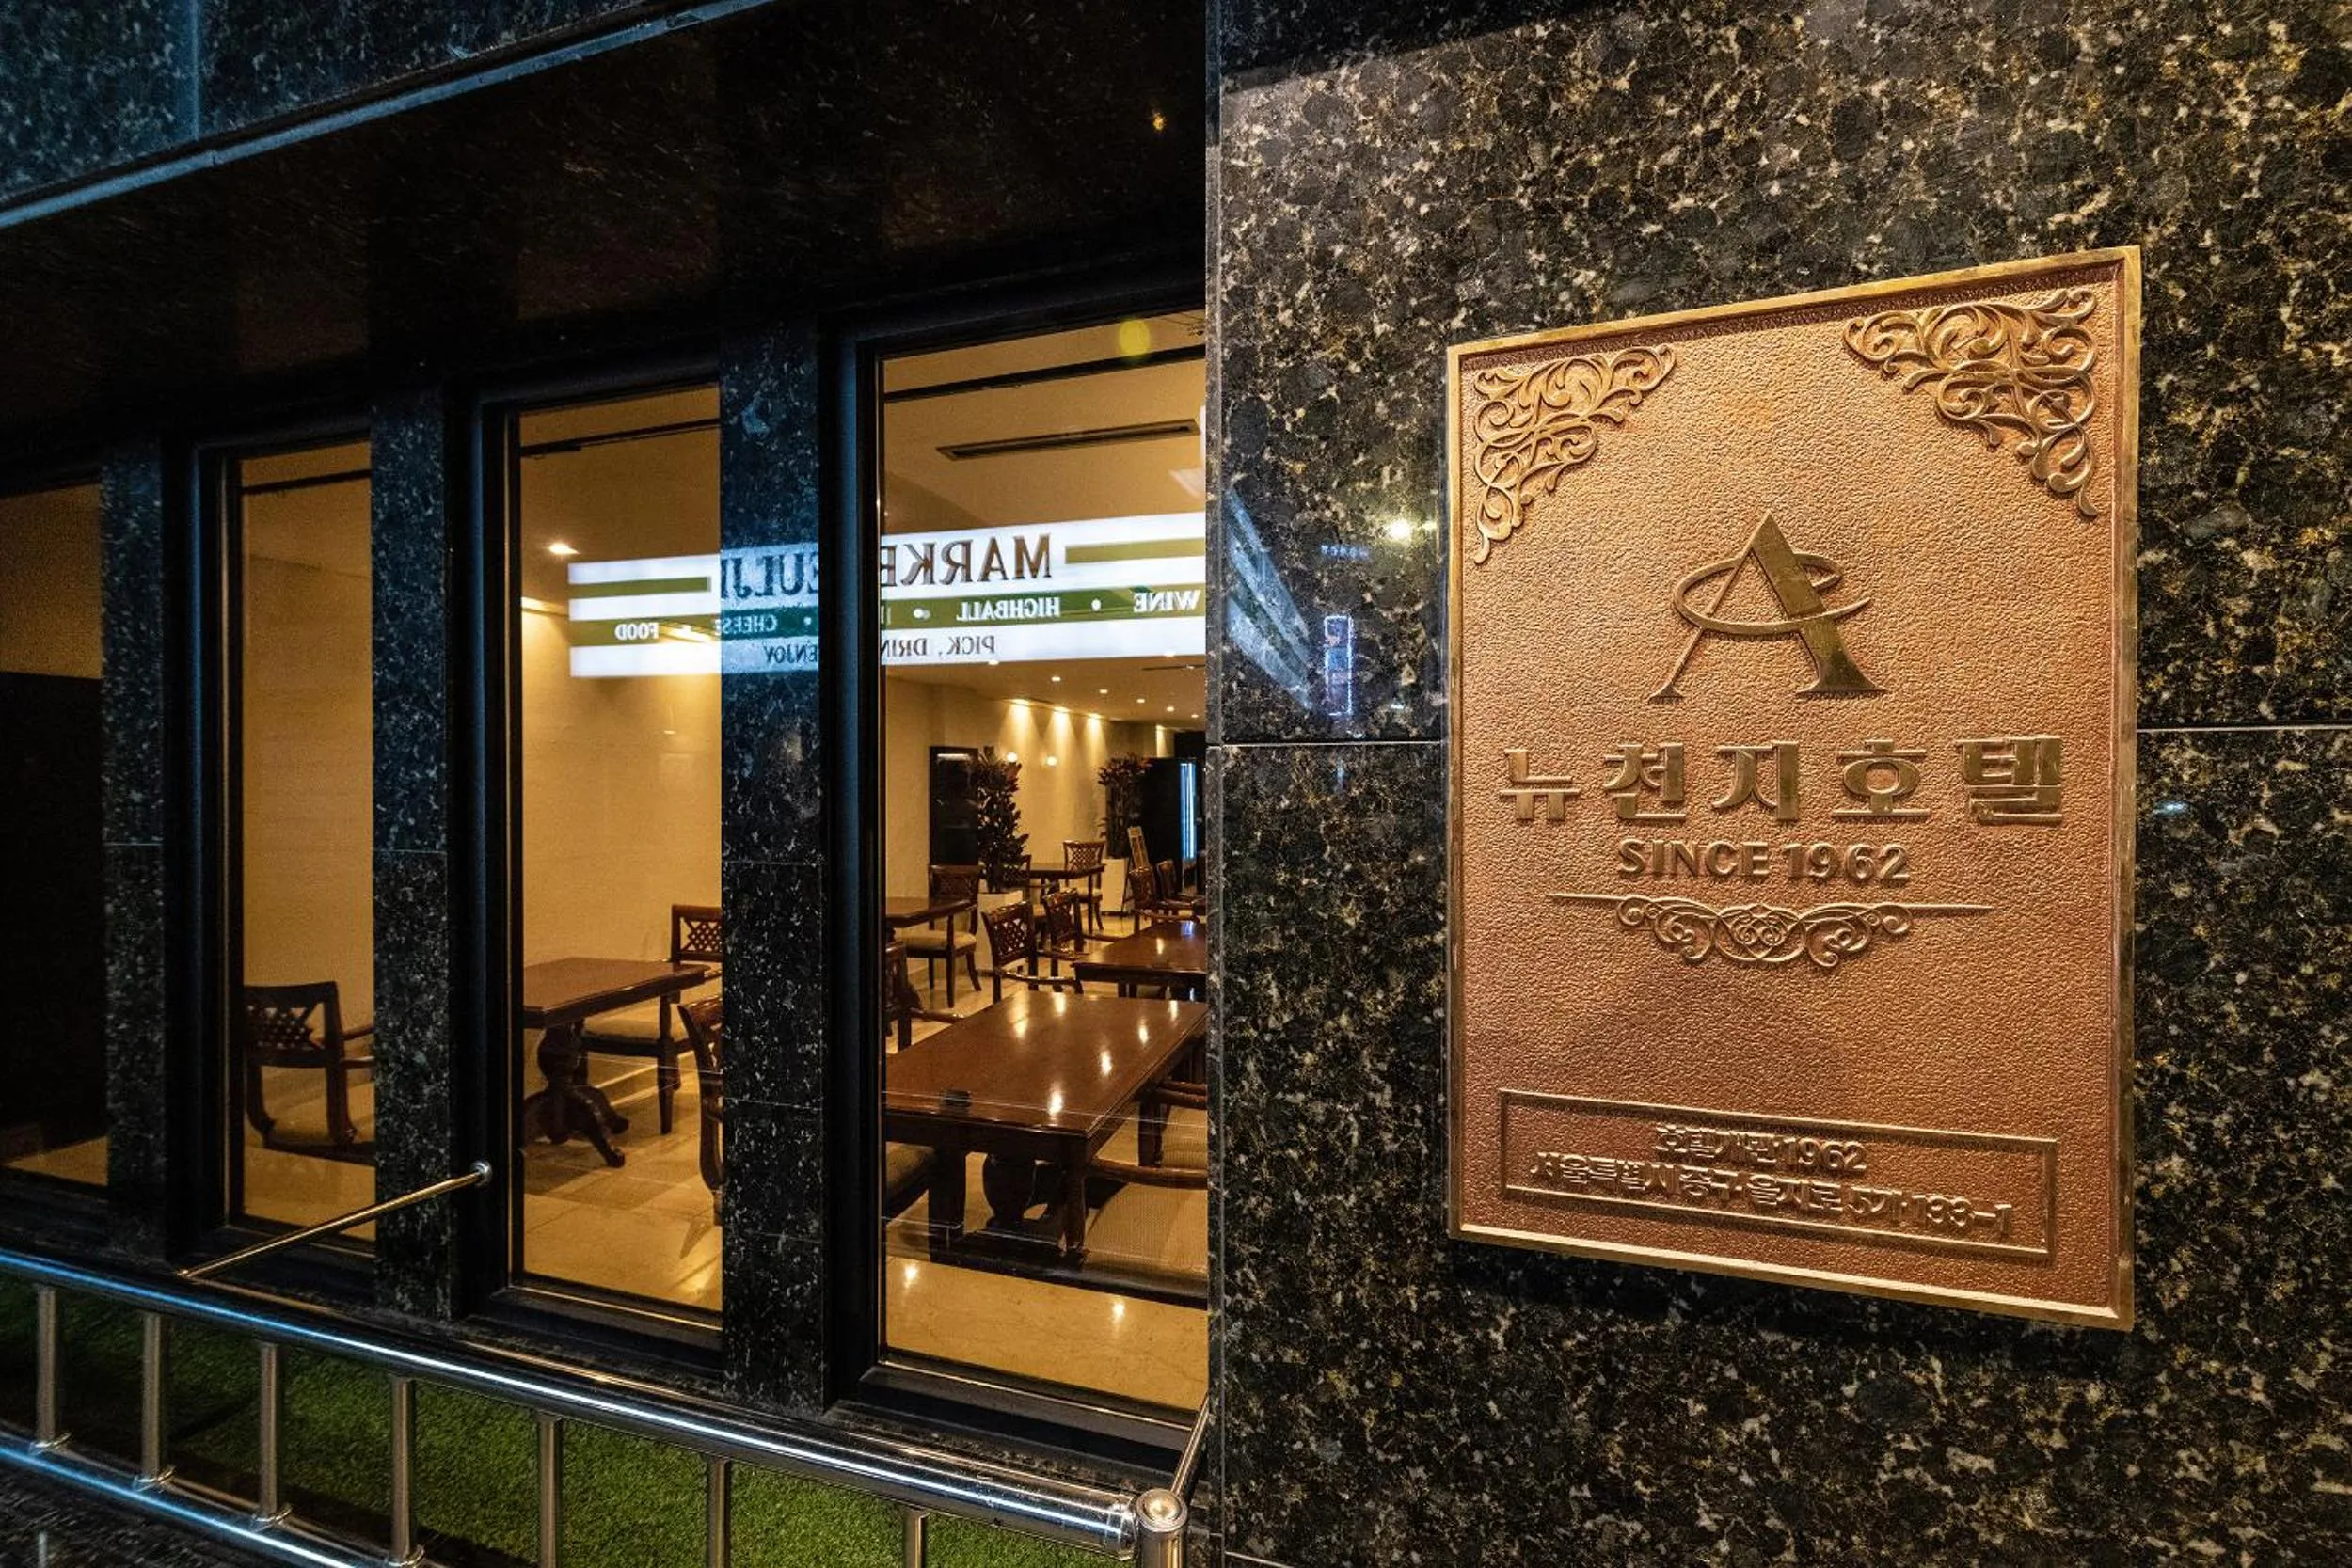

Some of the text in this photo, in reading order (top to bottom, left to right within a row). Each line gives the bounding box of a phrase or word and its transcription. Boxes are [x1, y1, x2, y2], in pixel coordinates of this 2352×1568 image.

[1500, 736, 2064, 826] 뉴천지호텔
[1617, 837, 1912, 882] SINCE 1962
